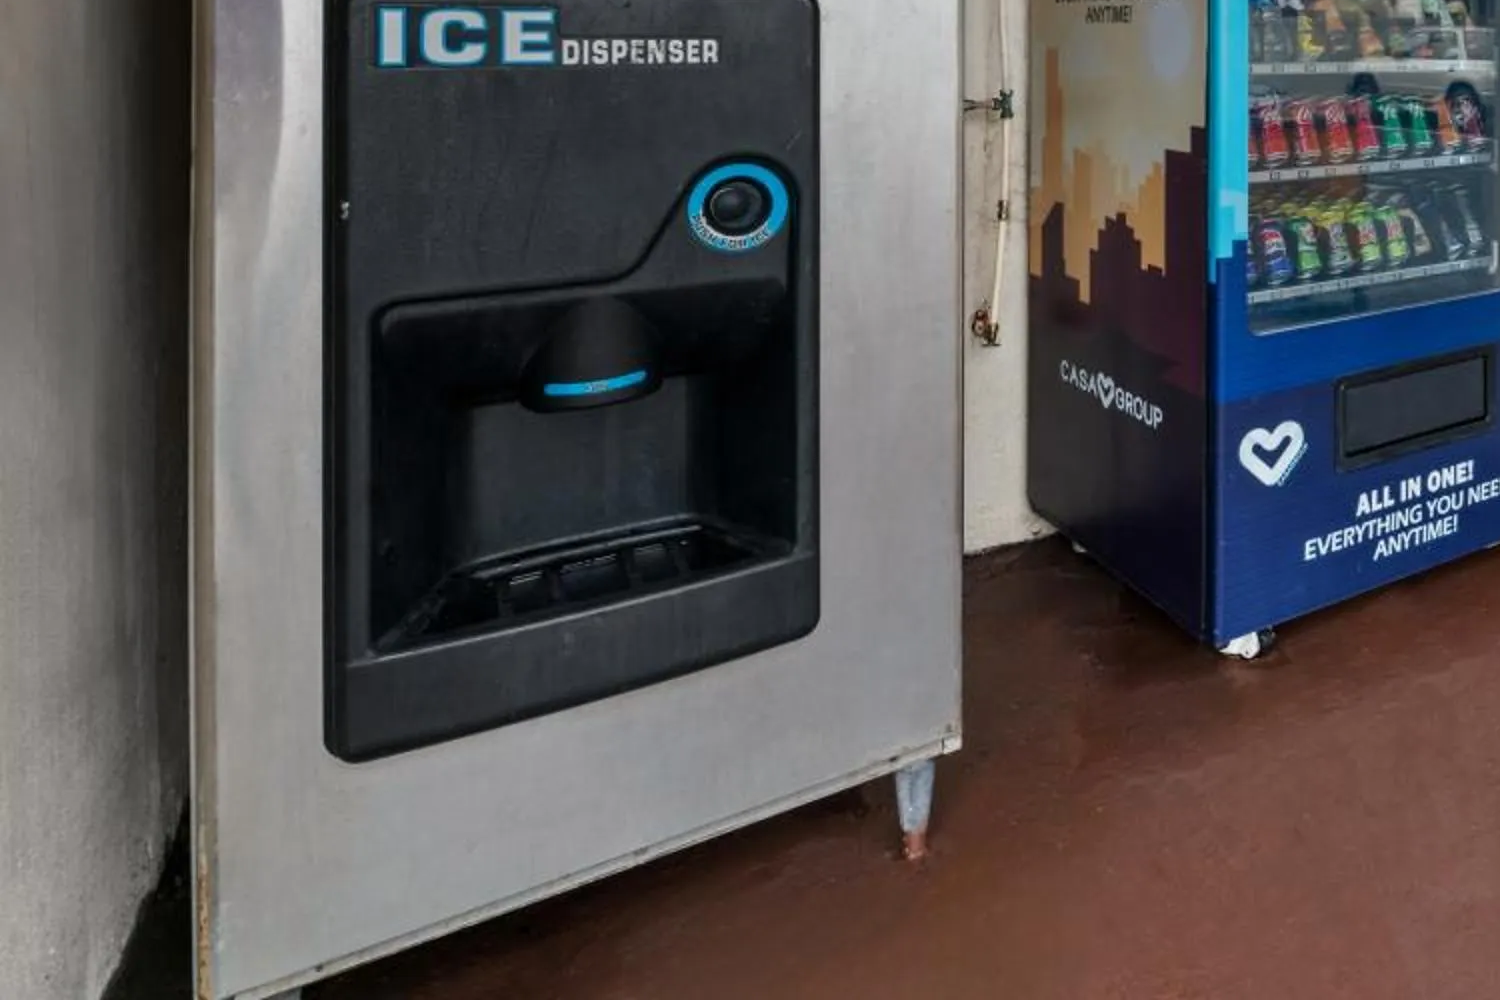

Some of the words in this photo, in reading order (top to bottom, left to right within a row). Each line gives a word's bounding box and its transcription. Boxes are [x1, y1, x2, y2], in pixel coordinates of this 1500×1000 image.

[377, 4, 557, 68] ICE
[562, 38, 719, 66] DISPENSER
[1085, 5, 1133, 24] ANYTIME!
[1060, 359, 1099, 400] CASA
[1115, 387, 1163, 431] GROUP
[1356, 485, 1395, 517] ALL
[1400, 476, 1422, 502] IN
[1427, 460, 1474, 492] ONE!
[1303, 503, 1423, 561] EVERYTHING
[1426, 490, 1464, 519] YOU
[1372, 514, 1459, 562] ANYTIME!
